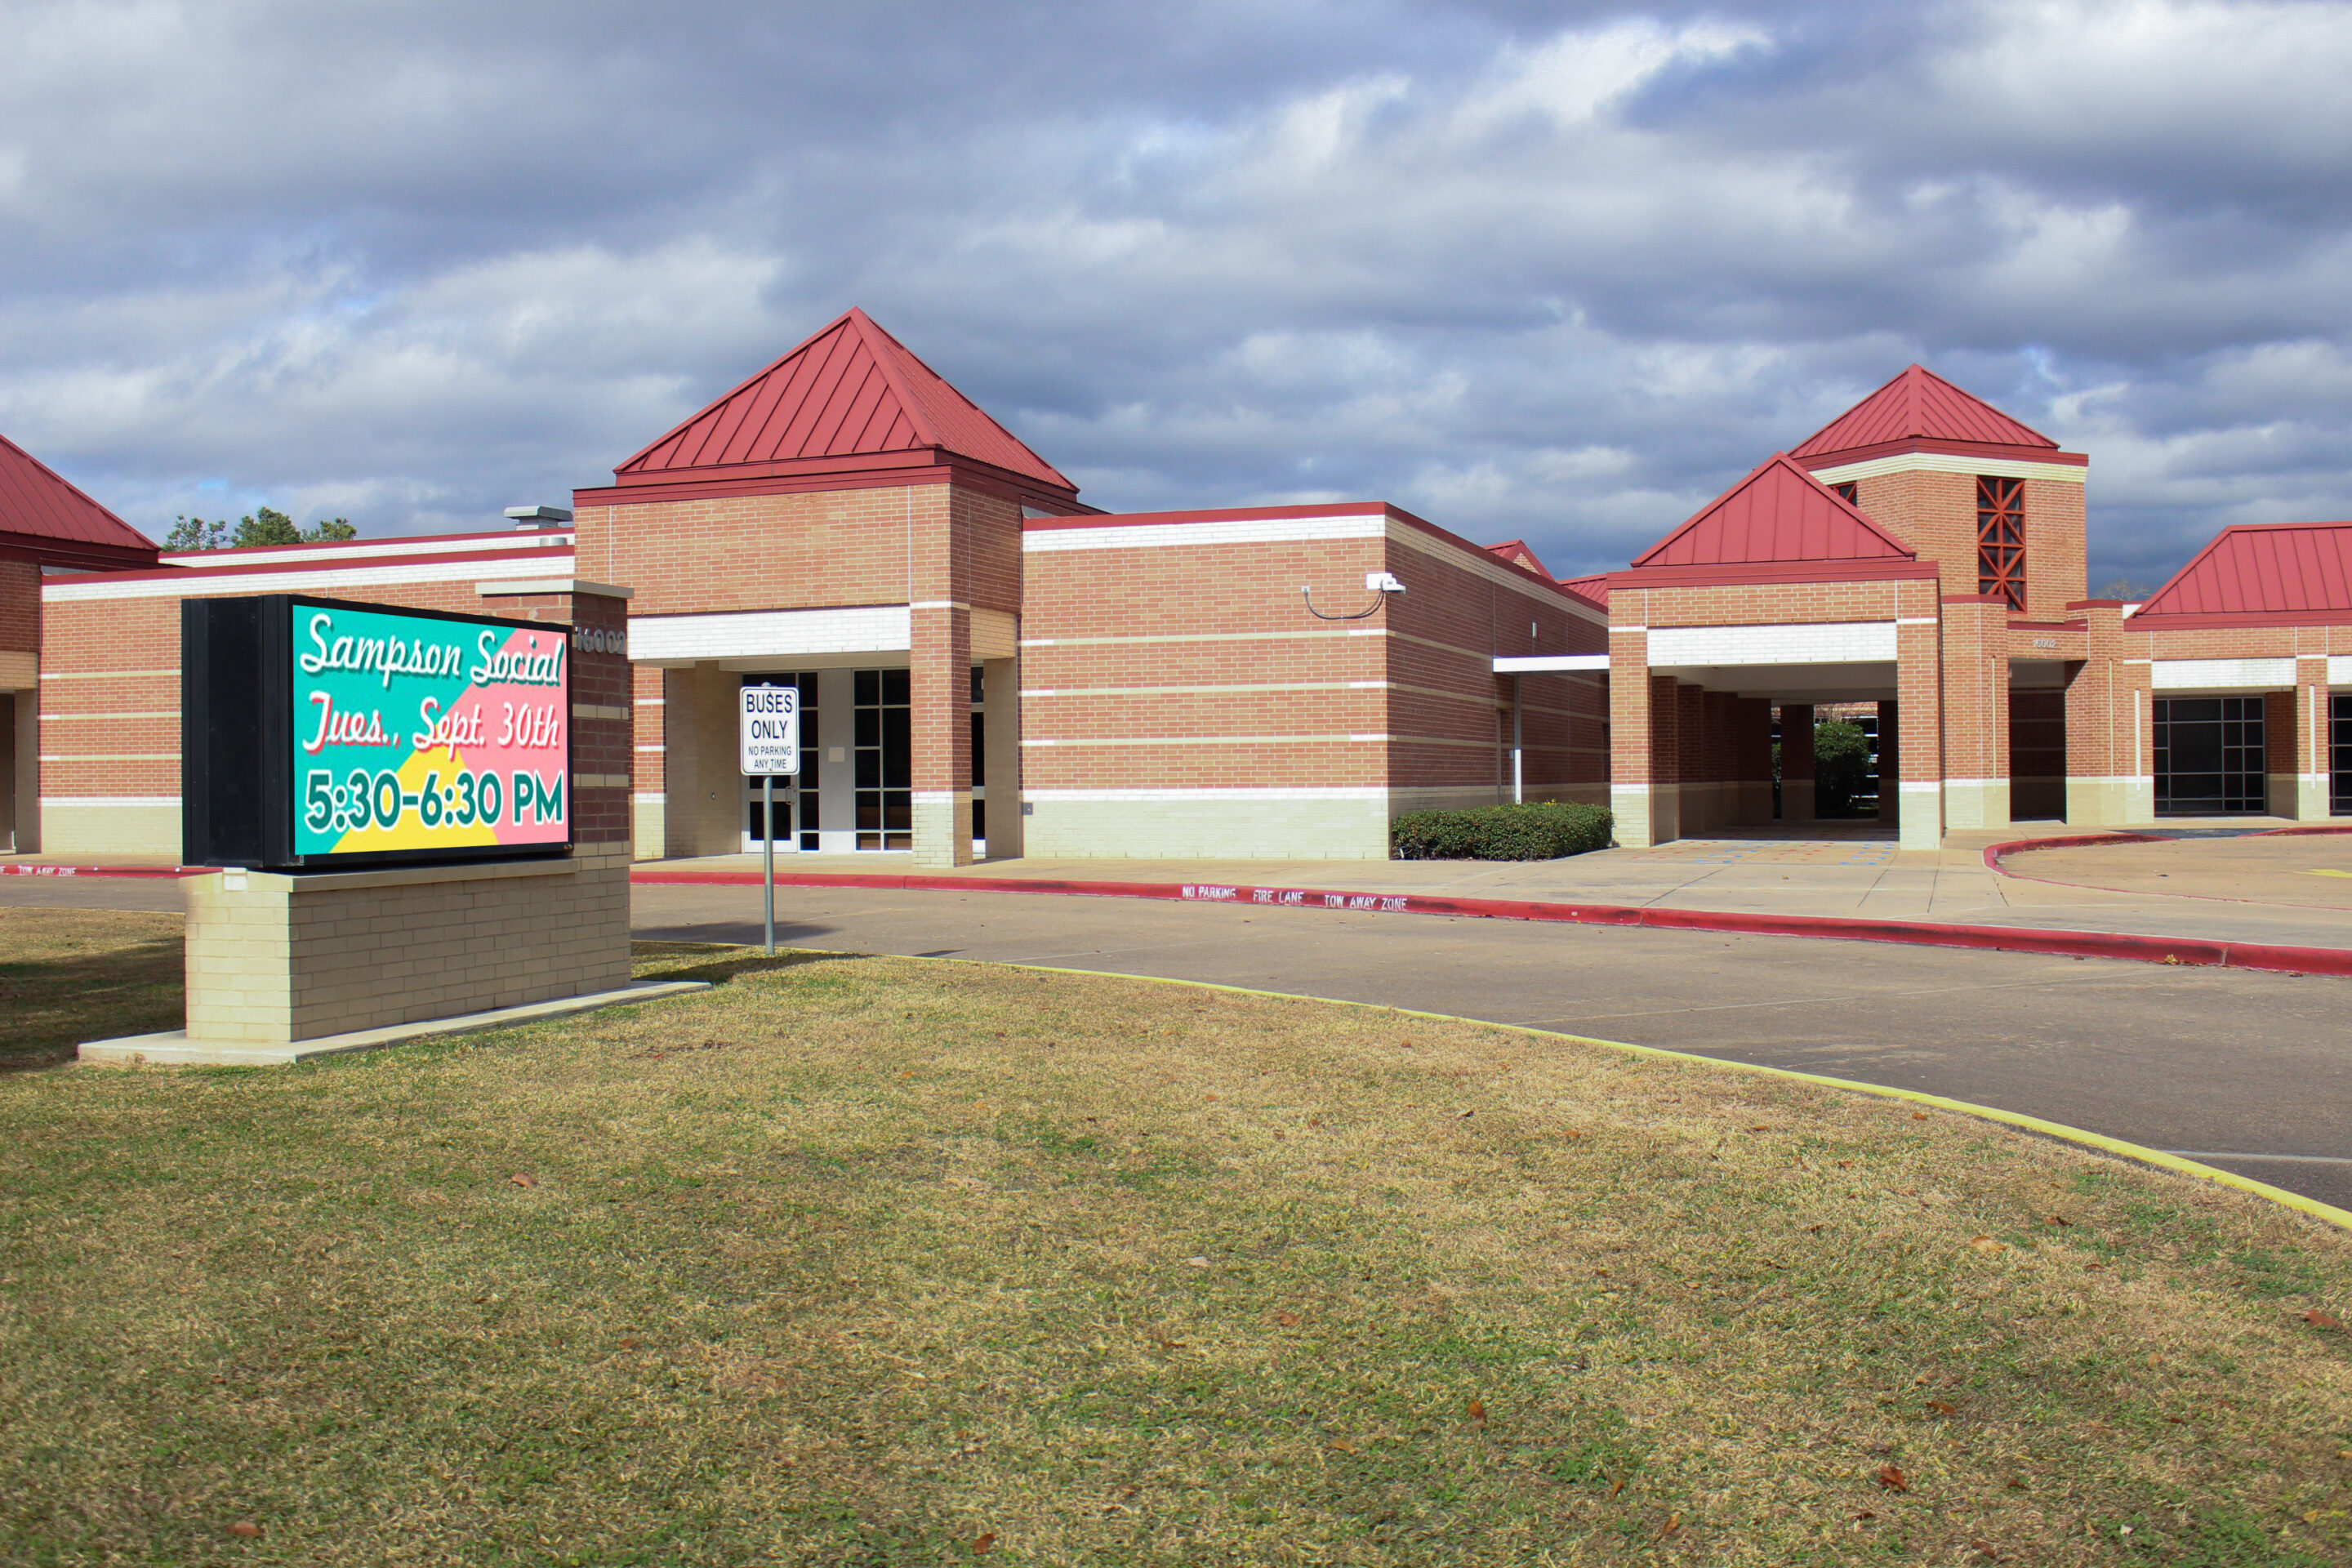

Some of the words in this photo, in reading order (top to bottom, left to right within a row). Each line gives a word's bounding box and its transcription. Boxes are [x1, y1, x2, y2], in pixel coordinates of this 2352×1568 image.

[300, 613, 461, 687] Sampson
[470, 630, 564, 684] Social
[575, 626, 626, 653] 16002
[746, 693, 792, 713] BUSES
[302, 691, 399, 750] Tues.,
[412, 697, 485, 757] Sept.
[497, 702, 559, 746] 30th
[751, 719, 788, 739] ONLY
[748, 746, 759, 755] NO
[760, 746, 791, 755] PARKING
[754, 759, 768, 768] ANY
[771, 759, 786, 768] TIME
[511, 769, 564, 826] PM
[1183, 886, 1195, 898] NO
[1198, 886, 1236, 898] PARKING
[1253, 890, 1274, 902] FIRE
[1279, 892, 1305, 903] LANE
[1325, 895, 1344, 909] TOW
[1349, 897, 1376, 909] AWAY
[1381, 898, 1408, 911] ZONE
